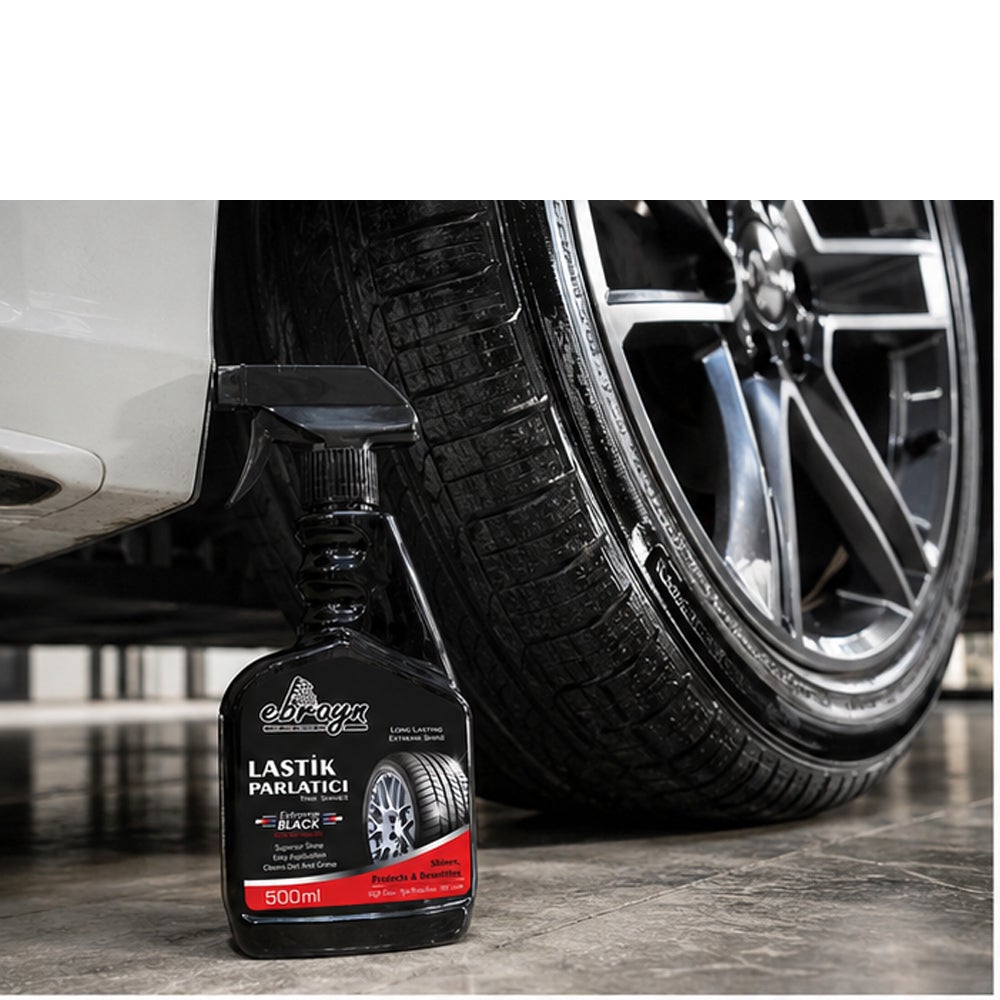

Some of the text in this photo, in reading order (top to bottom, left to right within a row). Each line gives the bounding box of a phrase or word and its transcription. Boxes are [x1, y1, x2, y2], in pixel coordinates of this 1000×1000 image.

[249, 755, 336, 778] LASTİK
[249, 779, 348, 795] PARLATICI
[277, 818, 320, 830] BLACK
[265, 889, 321, 906] 500ml
